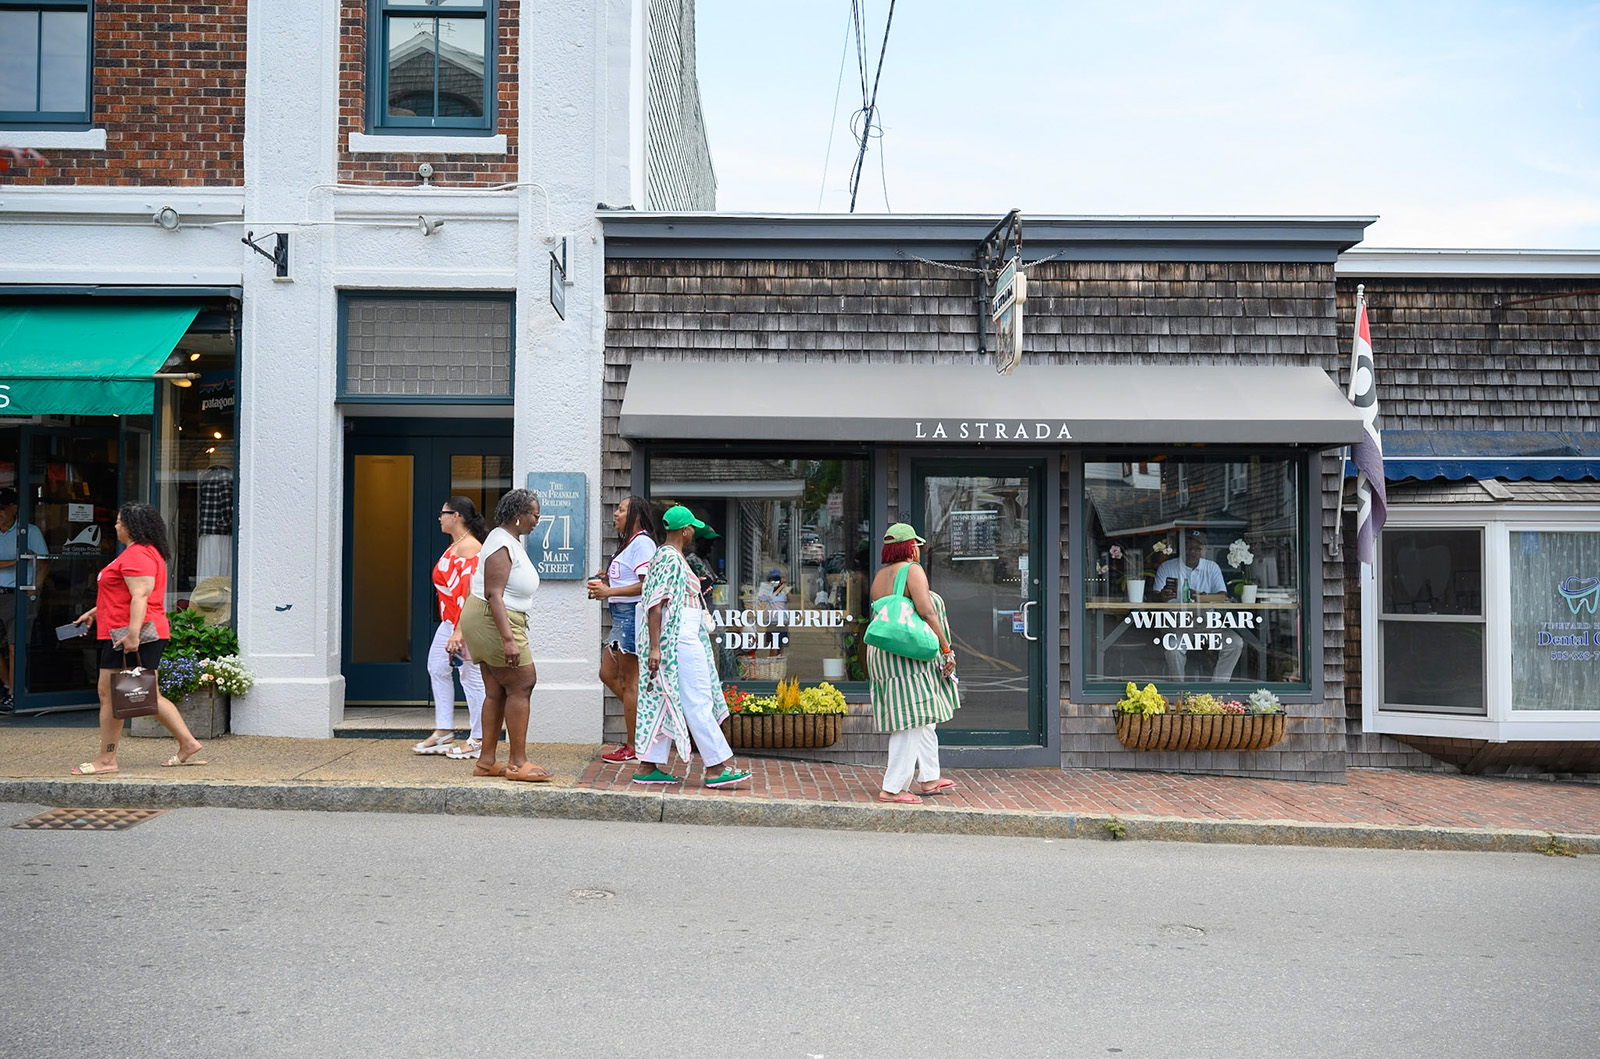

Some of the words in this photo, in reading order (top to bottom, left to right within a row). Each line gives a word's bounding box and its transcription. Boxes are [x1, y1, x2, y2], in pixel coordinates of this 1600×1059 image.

[915, 422, 948, 438] LA
[959, 422, 1073, 439] STRADA
[549, 481, 563, 490] THE
[548, 489, 580, 499] FRANKLIN
[541, 498, 571, 507] BUILDING
[538, 515, 574, 550] 71
[543, 550, 570, 562] MAIN
[537, 561, 574, 574] STREET
[1130, 611, 1194, 629] WINE
[1205, 611, 1255, 629] BAR
[724, 632, 780, 650] DELI
[1162, 633, 1223, 650] CAFE
[1538, 630, 1590, 646] Dental
